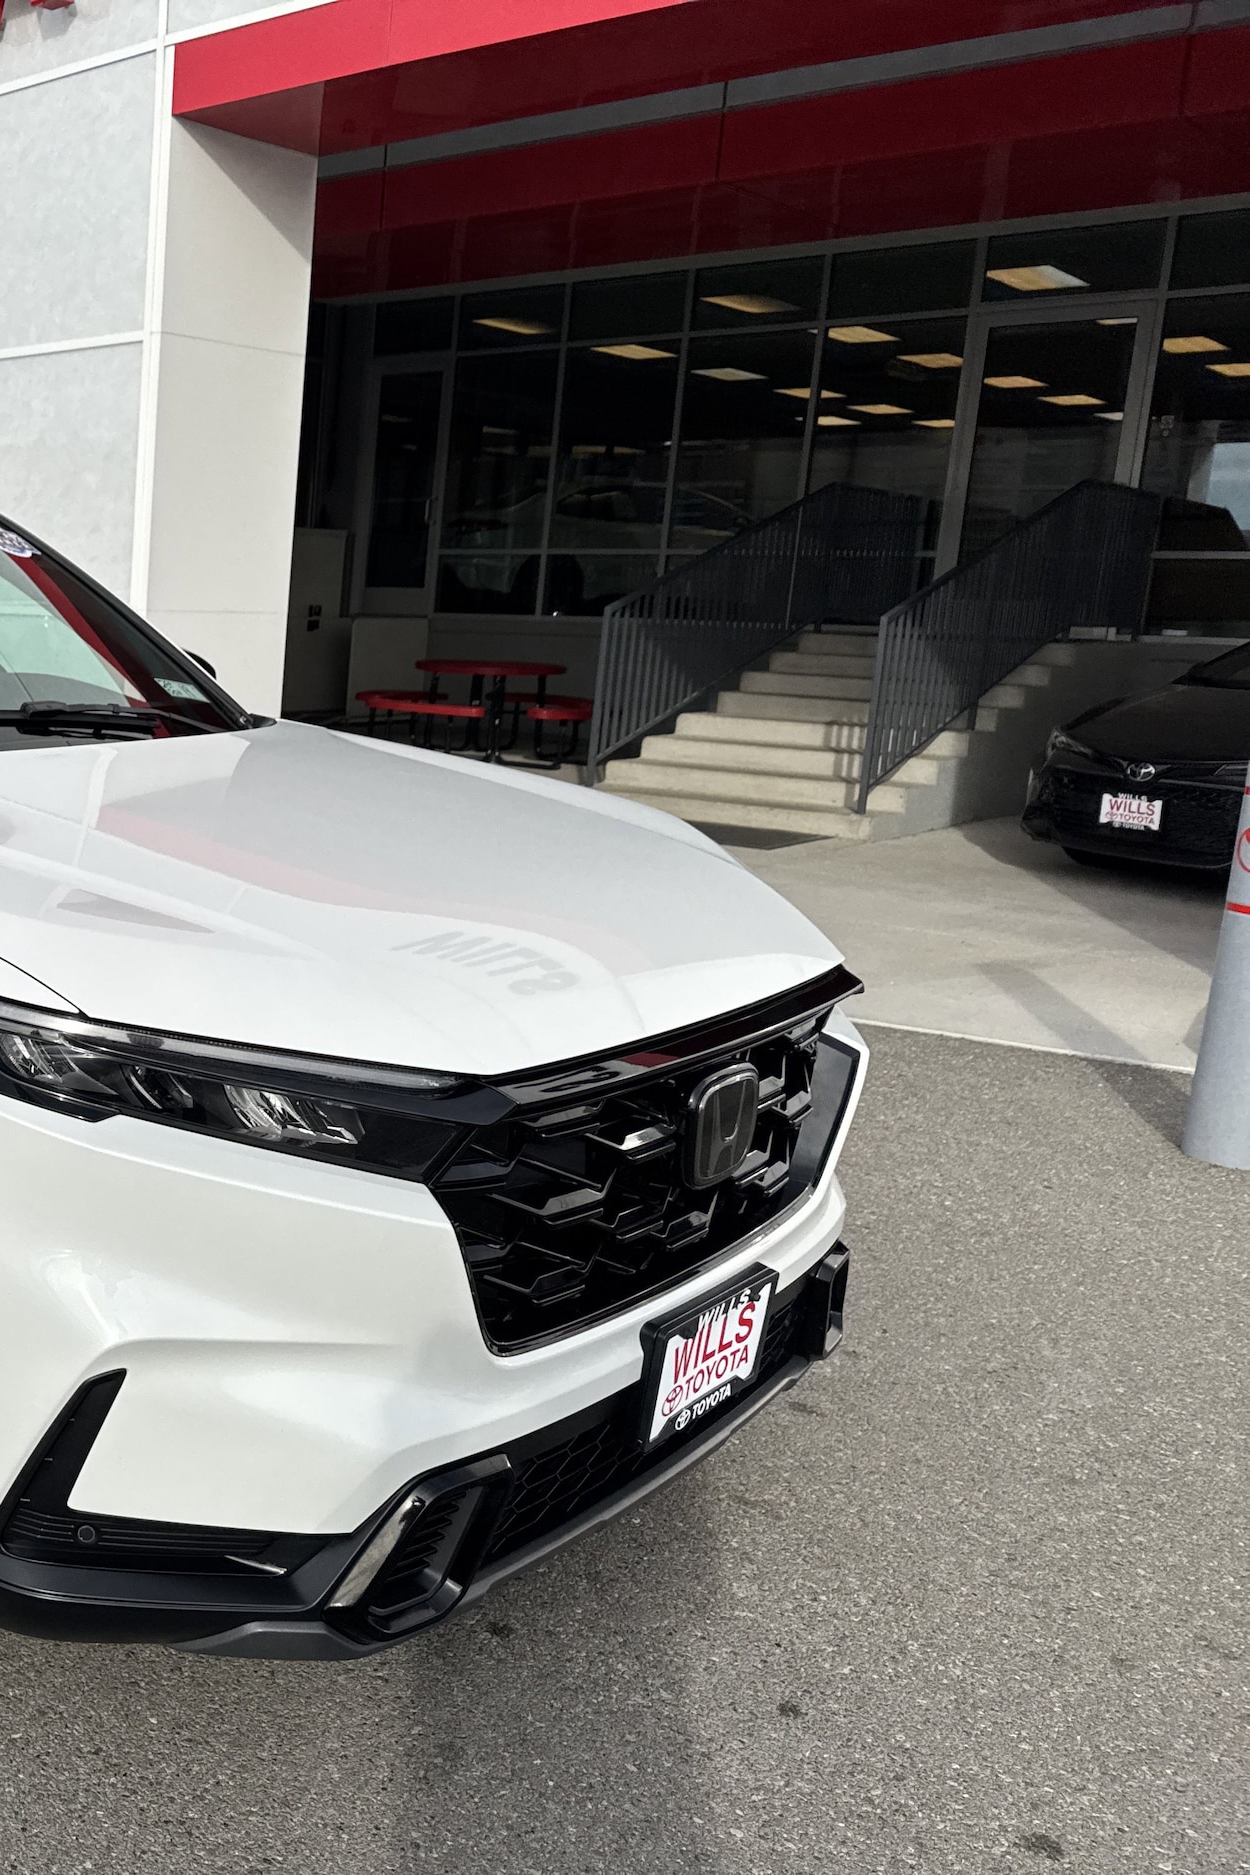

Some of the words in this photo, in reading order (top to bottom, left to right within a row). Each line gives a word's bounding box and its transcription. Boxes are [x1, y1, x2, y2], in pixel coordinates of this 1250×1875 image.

[1109, 799, 1156, 817] WILLS
[1119, 813, 1155, 826] TOYOTA
[697, 1287, 752, 1331] WILLS
[673, 1300, 756, 1386] WILLS
[685, 1344, 749, 1401] TOYOTA
[692, 1383, 732, 1420] TOYOTA
